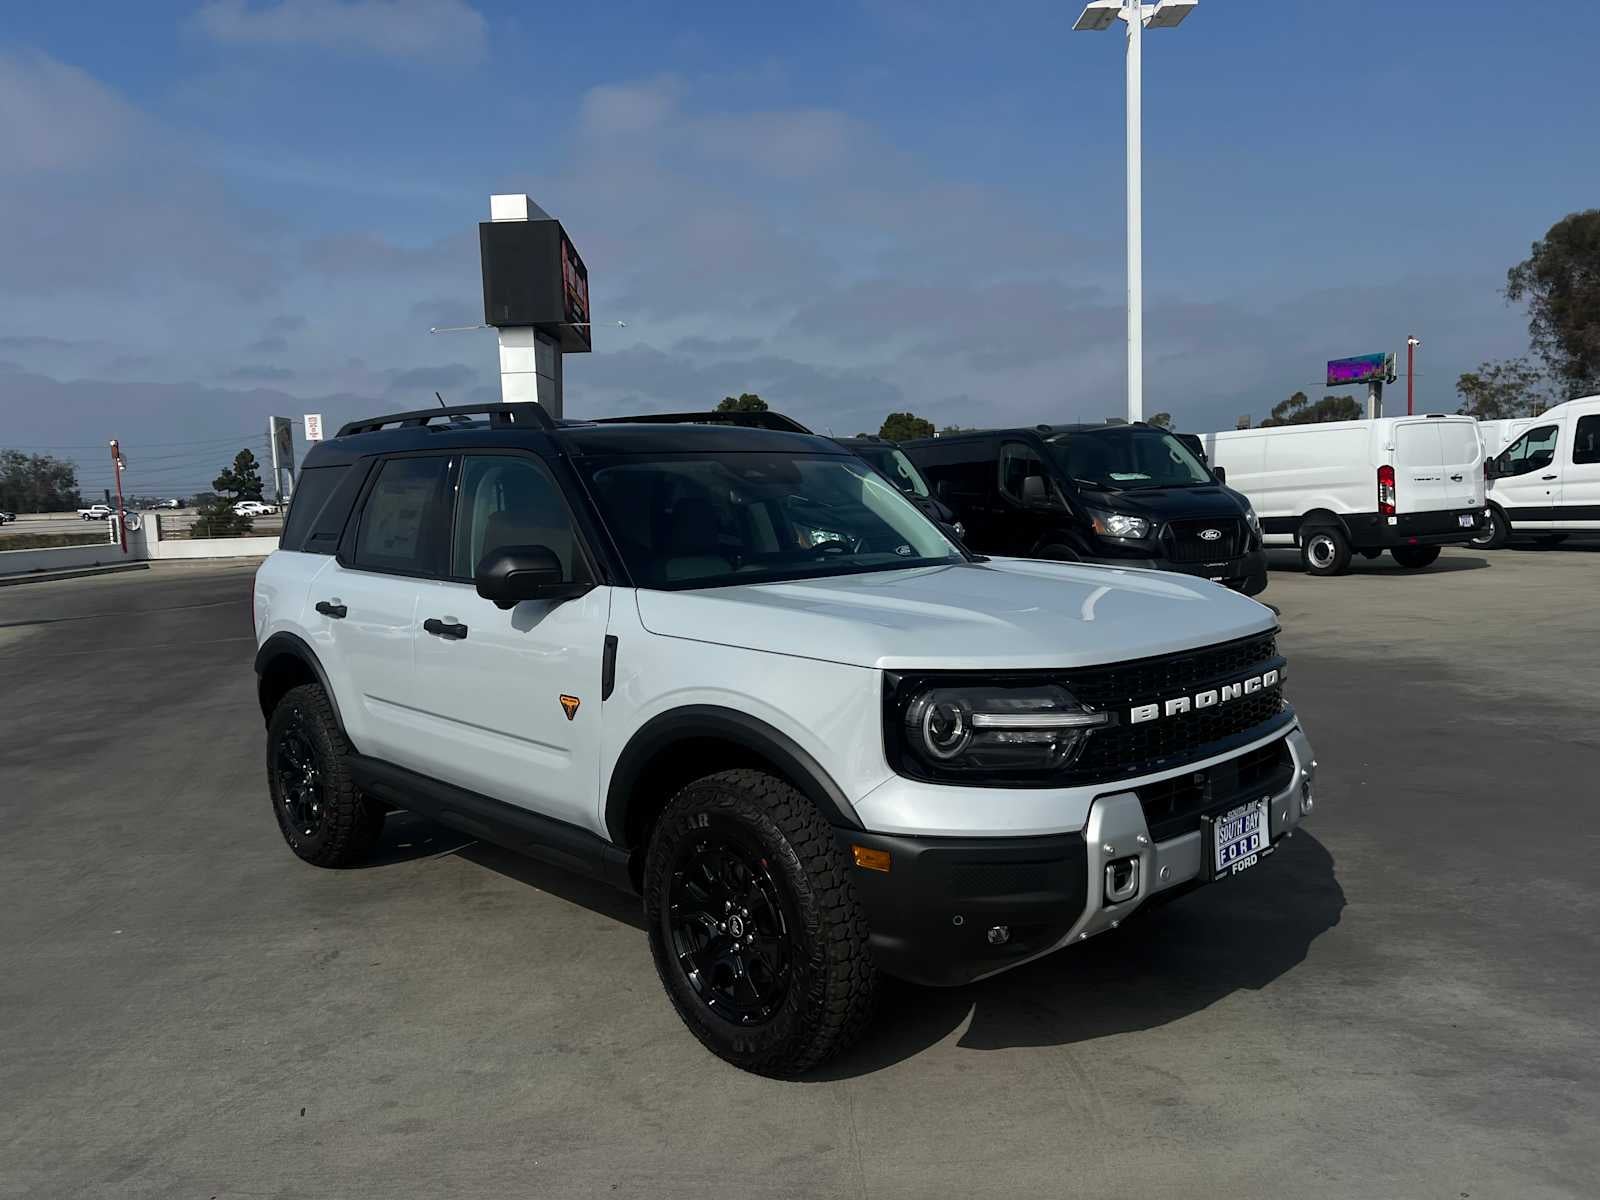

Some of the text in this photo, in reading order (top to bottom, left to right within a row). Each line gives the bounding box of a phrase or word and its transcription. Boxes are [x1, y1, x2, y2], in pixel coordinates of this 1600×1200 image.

[1130, 669, 1279, 724] BRONCO
[1219, 811, 1259, 844] SOUTH BAY
[1220, 834, 1259, 865] FORD
[1232, 853, 1258, 875] FORD
